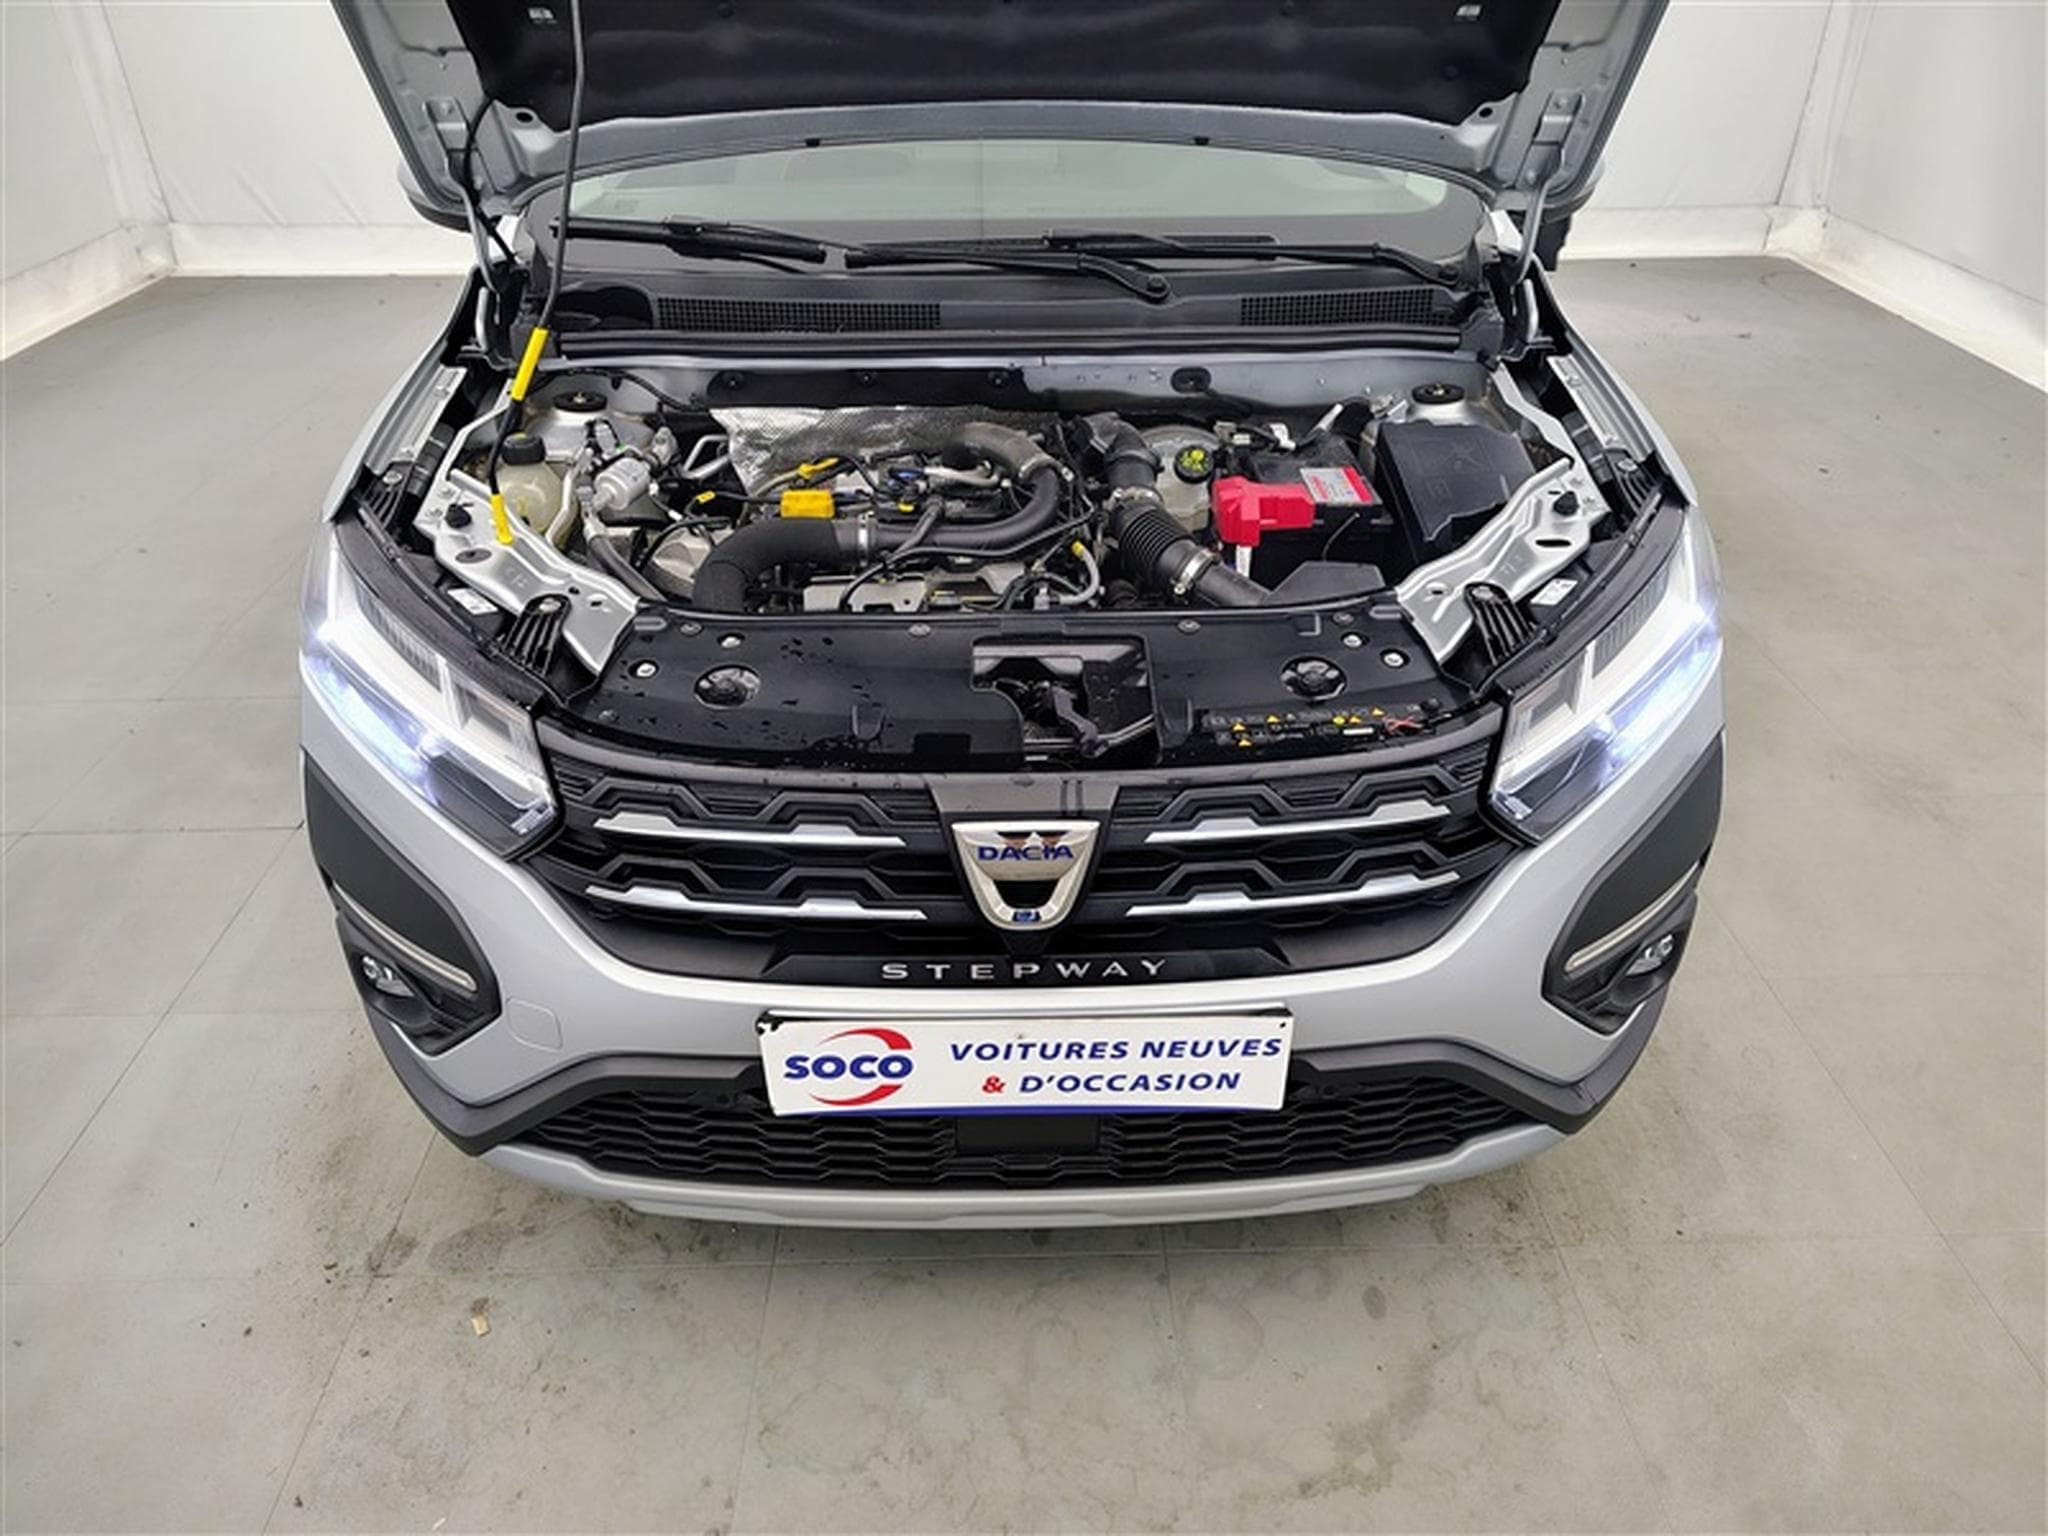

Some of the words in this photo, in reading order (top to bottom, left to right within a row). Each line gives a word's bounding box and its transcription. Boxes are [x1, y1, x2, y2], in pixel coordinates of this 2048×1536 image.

[977, 845, 1074, 861] DACIA
[881, 958, 1166, 980] STEPWAY
[951, 1041, 1128, 1062] VOITURES
[1140, 1038, 1282, 1058] NEUVES
[783, 1053, 914, 1081] SOCO
[981, 1075, 1006, 1095] &
[1019, 1072, 1241, 1093] D'OCCASION
